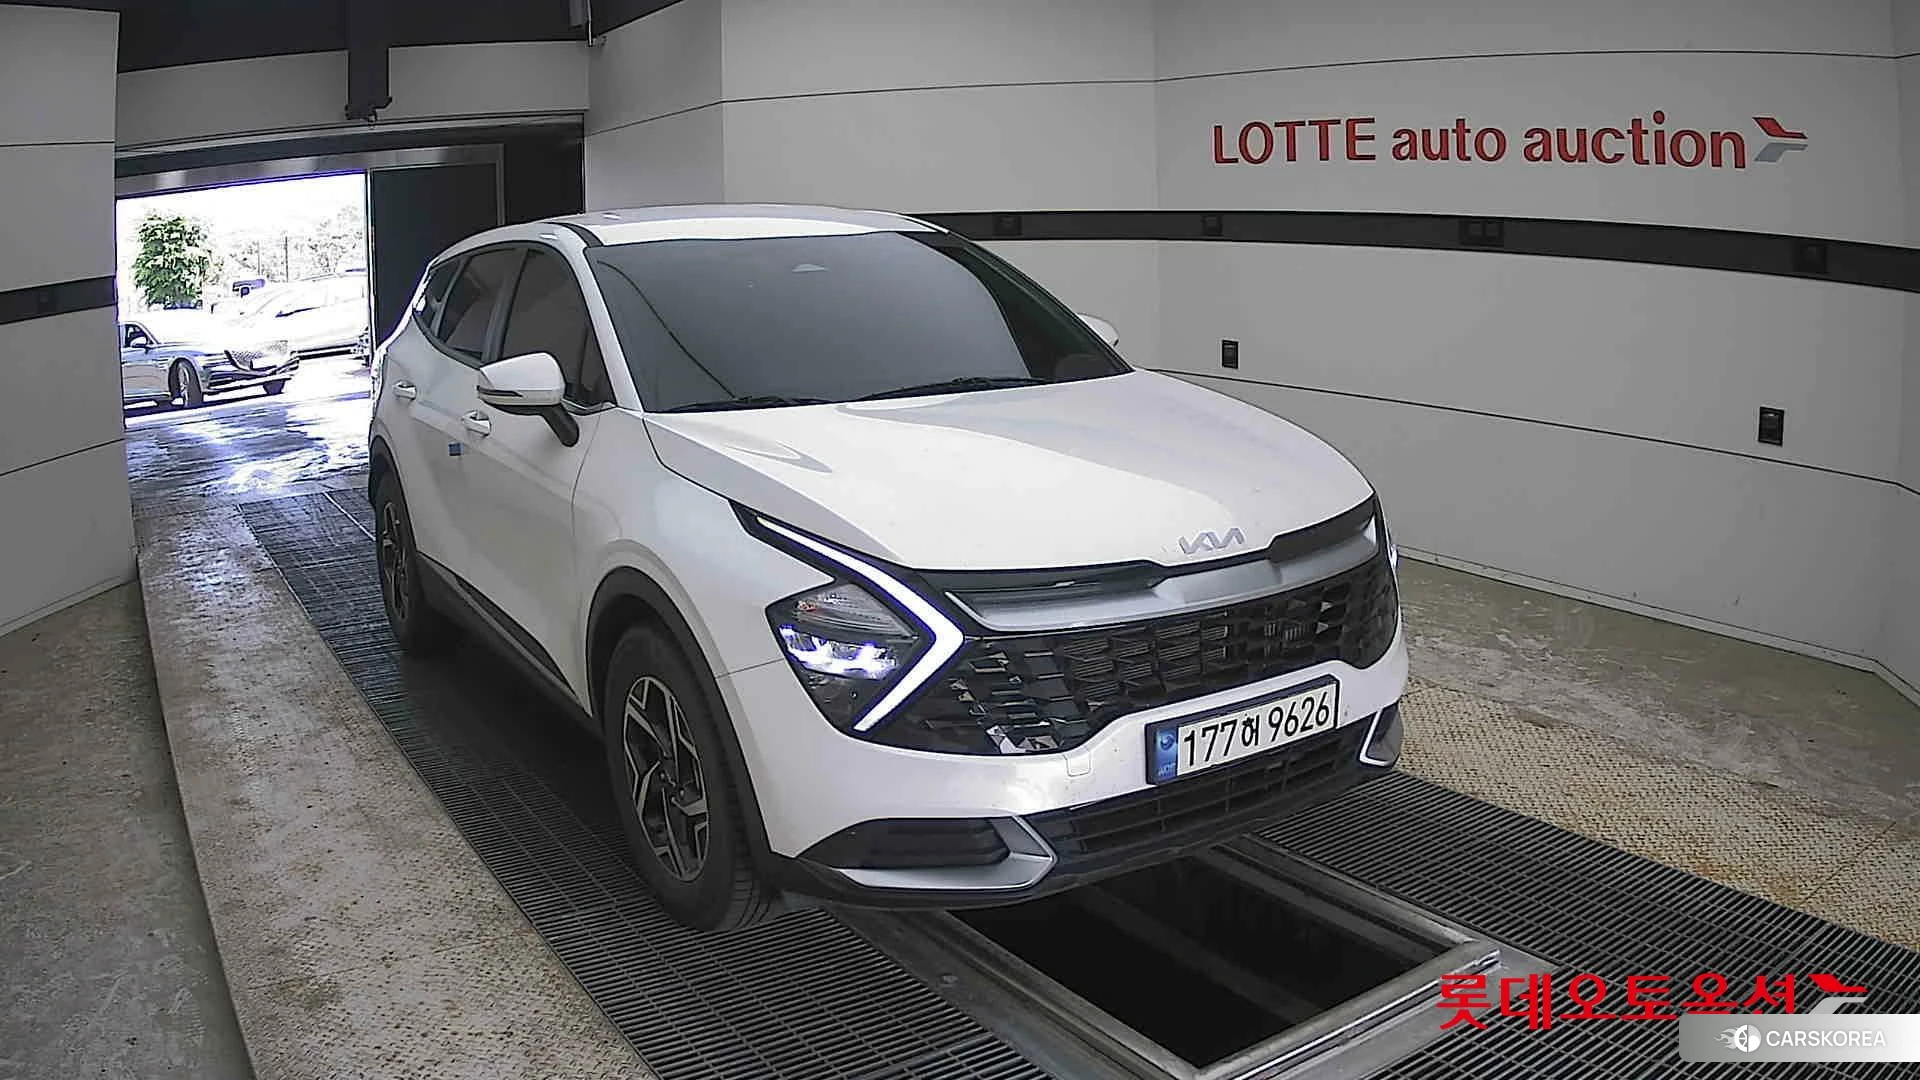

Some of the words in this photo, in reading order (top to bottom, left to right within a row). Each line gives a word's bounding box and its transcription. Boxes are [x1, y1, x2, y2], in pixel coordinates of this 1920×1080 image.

[1213, 116, 1377, 165] LOTTE
[1391, 118, 1508, 163] auto
[1522, 110, 1747, 169] auction
[1183, 713, 1260, 767] 177허
[1267, 691, 1330, 743] 9626
